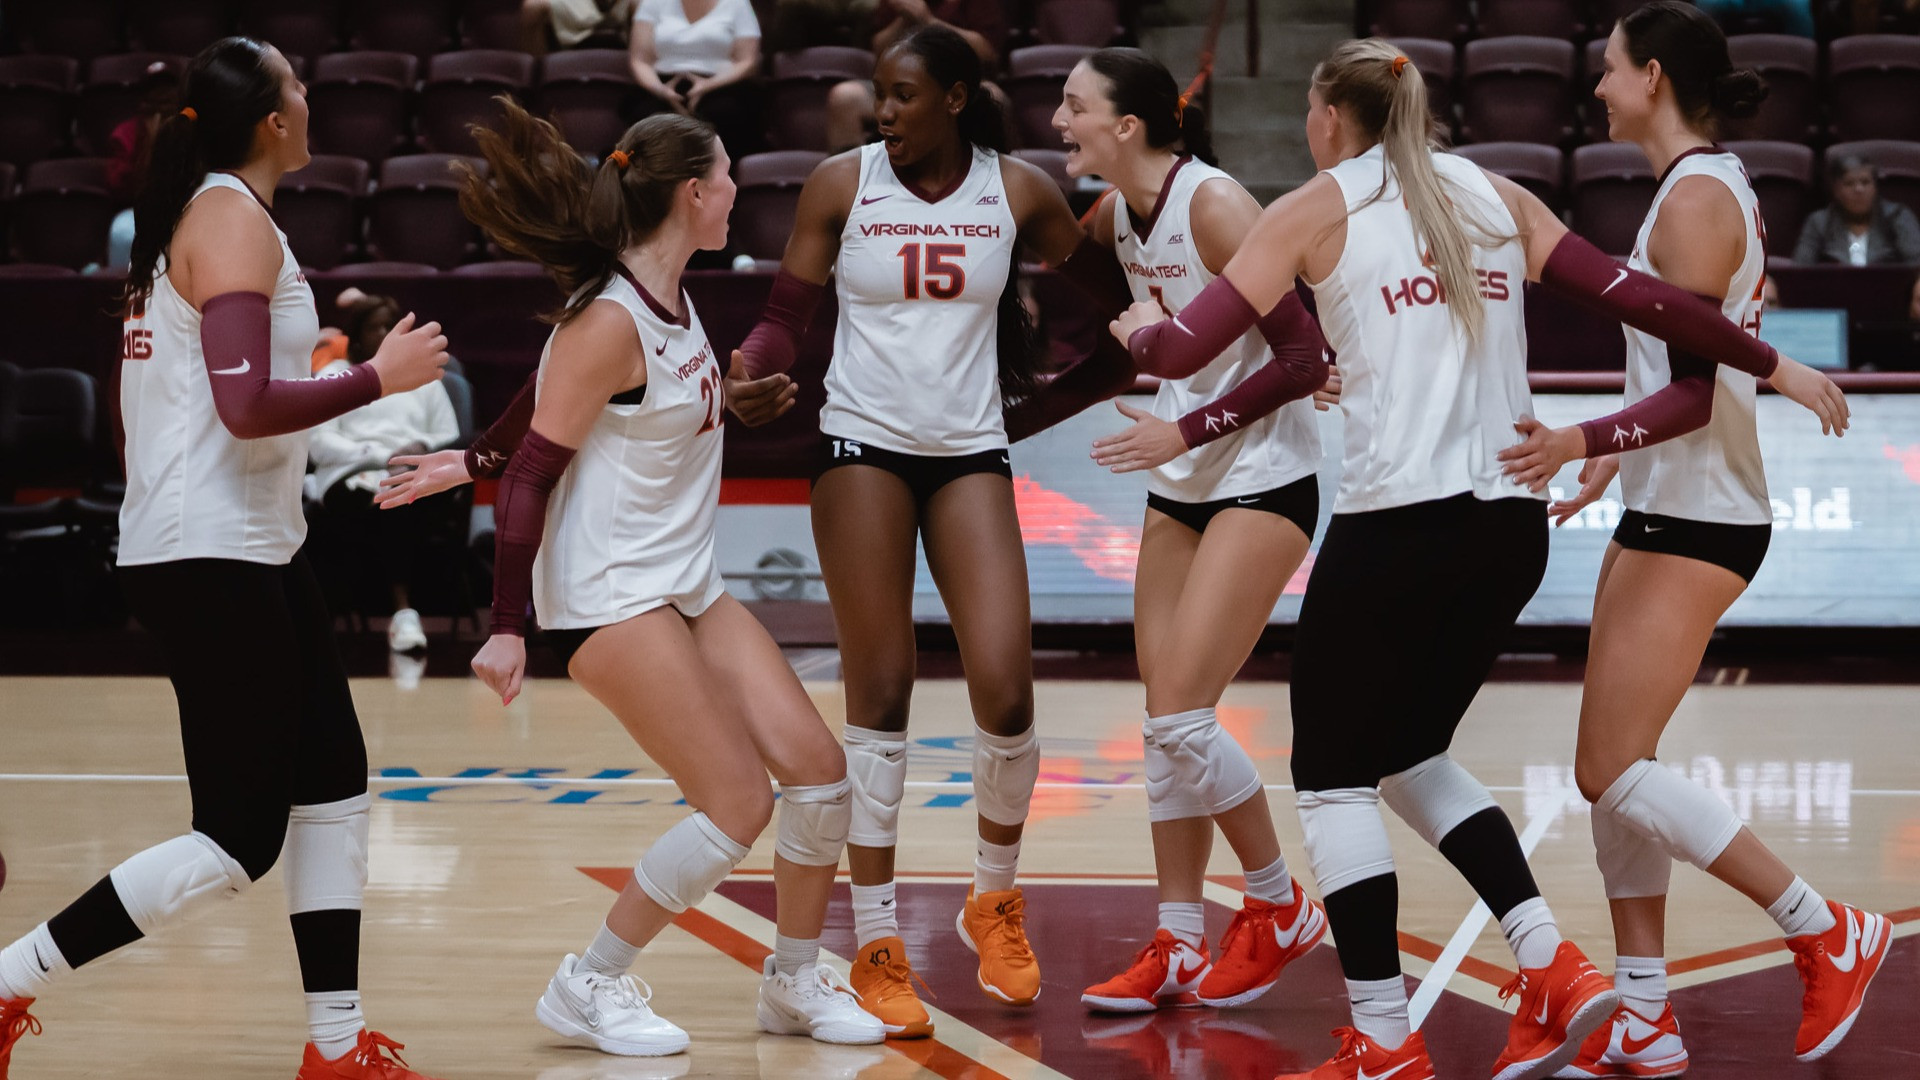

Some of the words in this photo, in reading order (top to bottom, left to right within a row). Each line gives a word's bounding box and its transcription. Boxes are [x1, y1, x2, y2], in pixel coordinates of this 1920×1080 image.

[975, 195, 999, 206] ACC
[859, 223, 949, 237] VIRGINIA
[950, 224, 1000, 239] TECH
[1167, 233, 1184, 244] ACC
[896, 242, 966, 301] 15
[1156, 264, 1187, 278] TECH
[1380, 269, 1510, 316] HOES
